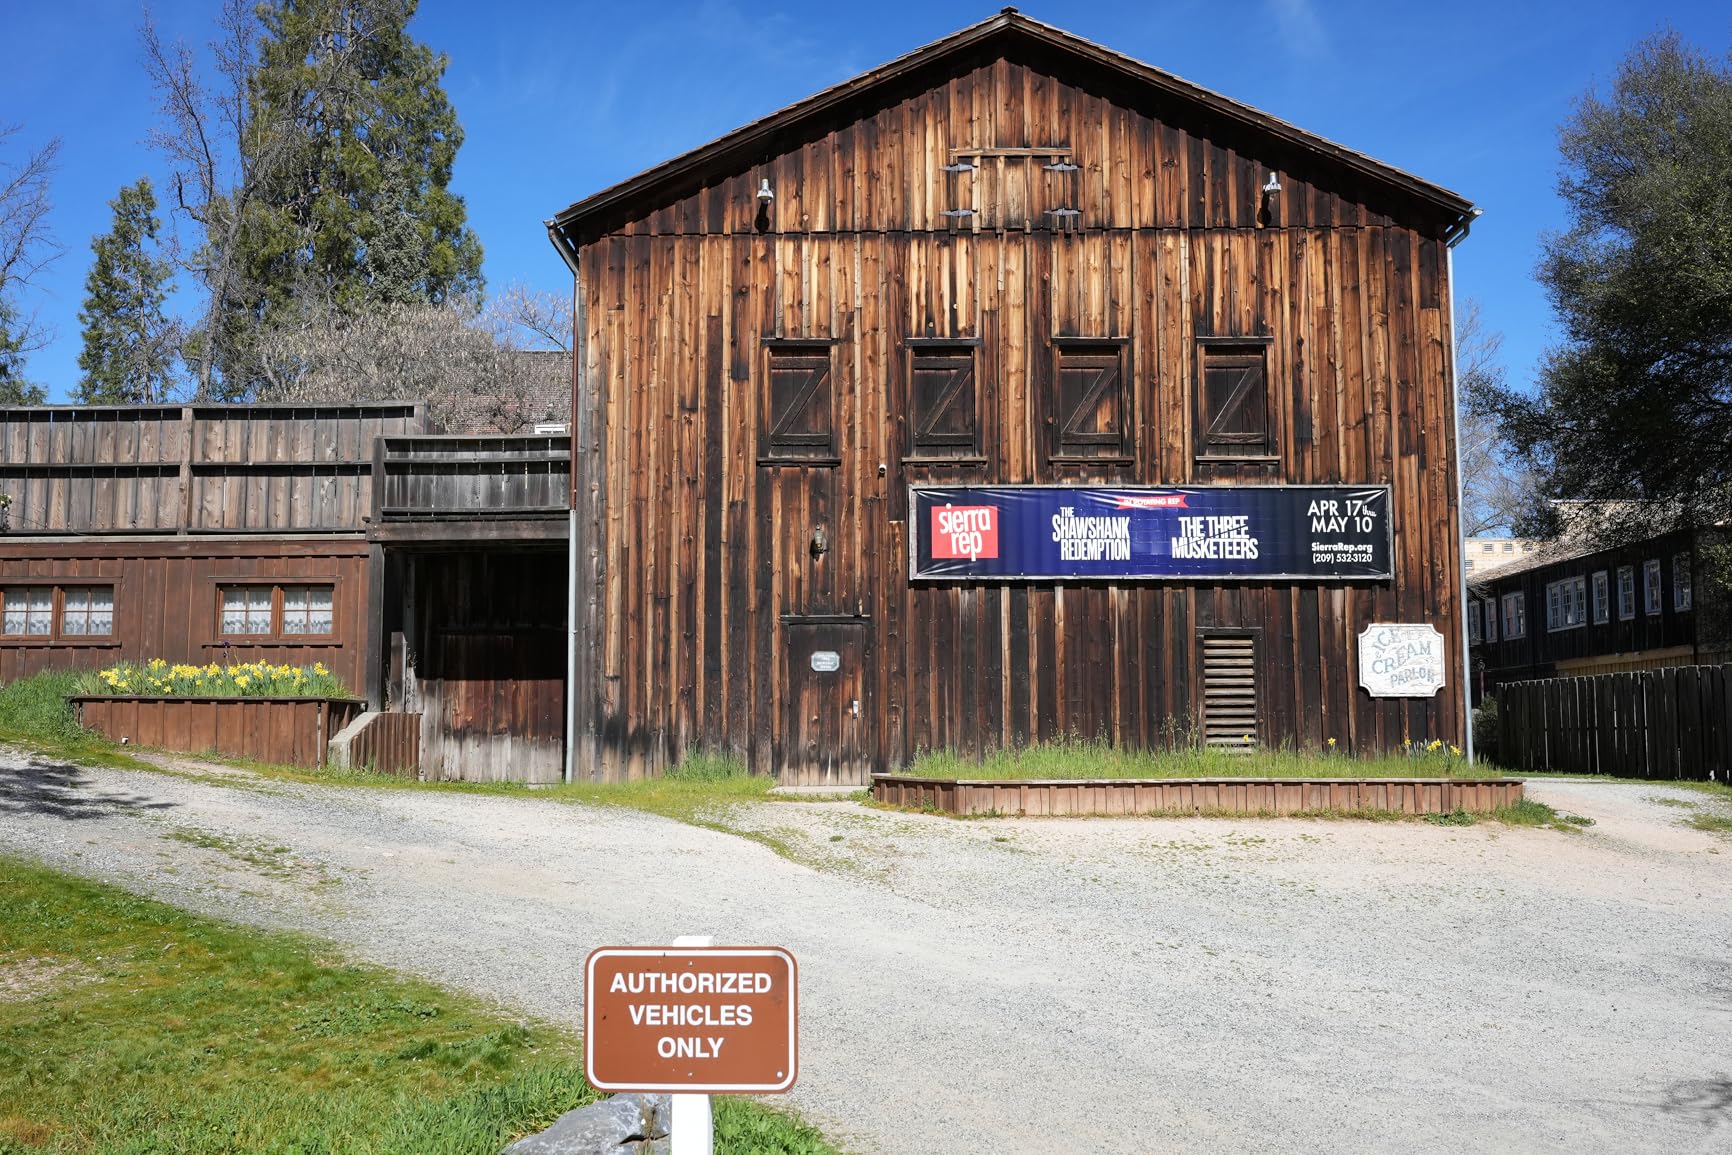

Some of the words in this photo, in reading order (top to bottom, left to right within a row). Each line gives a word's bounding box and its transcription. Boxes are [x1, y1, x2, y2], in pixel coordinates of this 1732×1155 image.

[1060, 507, 1075, 517] THE
[1307, 499, 1339, 516] APR
[1345, 500, 1363, 516] 17
[938, 503, 991, 534] sierra
[1052, 514, 1130, 542] SHAWSHANK
[1178, 517, 1206, 539] THE
[1206, 516, 1250, 539] THREE
[1311, 516, 1348, 533] MAY
[1354, 516, 1373, 533] 10
[951, 531, 983, 561] rep
[1060, 539, 1131, 560] REDEMPTION
[1171, 537, 1258, 560] MUSKETEERS
[1311, 542, 1373, 553] SierraRep.org
[1313, 553, 1334, 564] (209)
[1336, 553, 1373, 563] 532-3120
[1371, 628, 1402, 654] ICE
[1371, 640, 1432, 675] CREAM
[1390, 667, 1435, 688] PARLOR
[610, 972, 772, 993] AUTHORIZED
[629, 1004, 753, 1026] VEHICLES
[657, 1037, 724, 1058] ONLY
